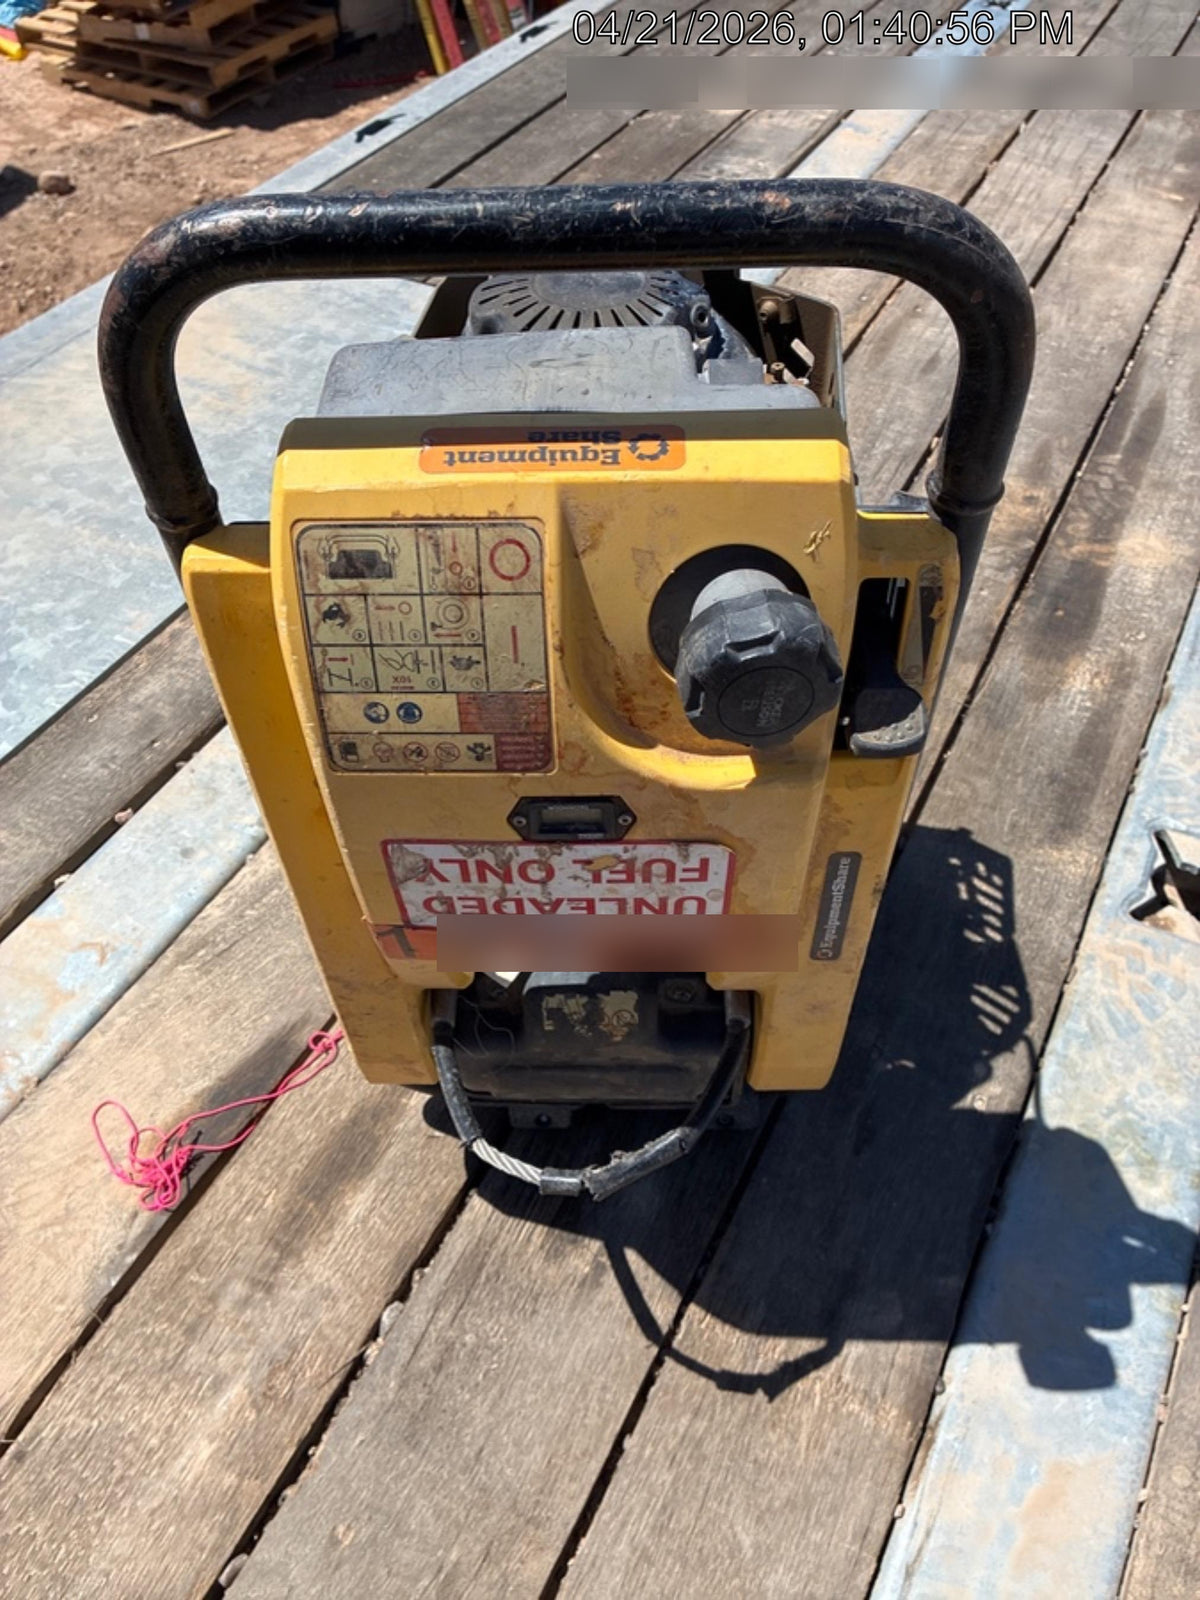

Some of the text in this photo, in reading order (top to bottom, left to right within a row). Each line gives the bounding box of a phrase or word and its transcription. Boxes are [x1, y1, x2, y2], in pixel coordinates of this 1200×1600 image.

[527, 430, 622, 444] Share
[443, 446, 621, 466] Equipment
[416, 857, 710, 884] FUEL ONLY
[423, 897, 707, 915] UNLEADED
[819, 857, 851, 949] EquipmentShare
